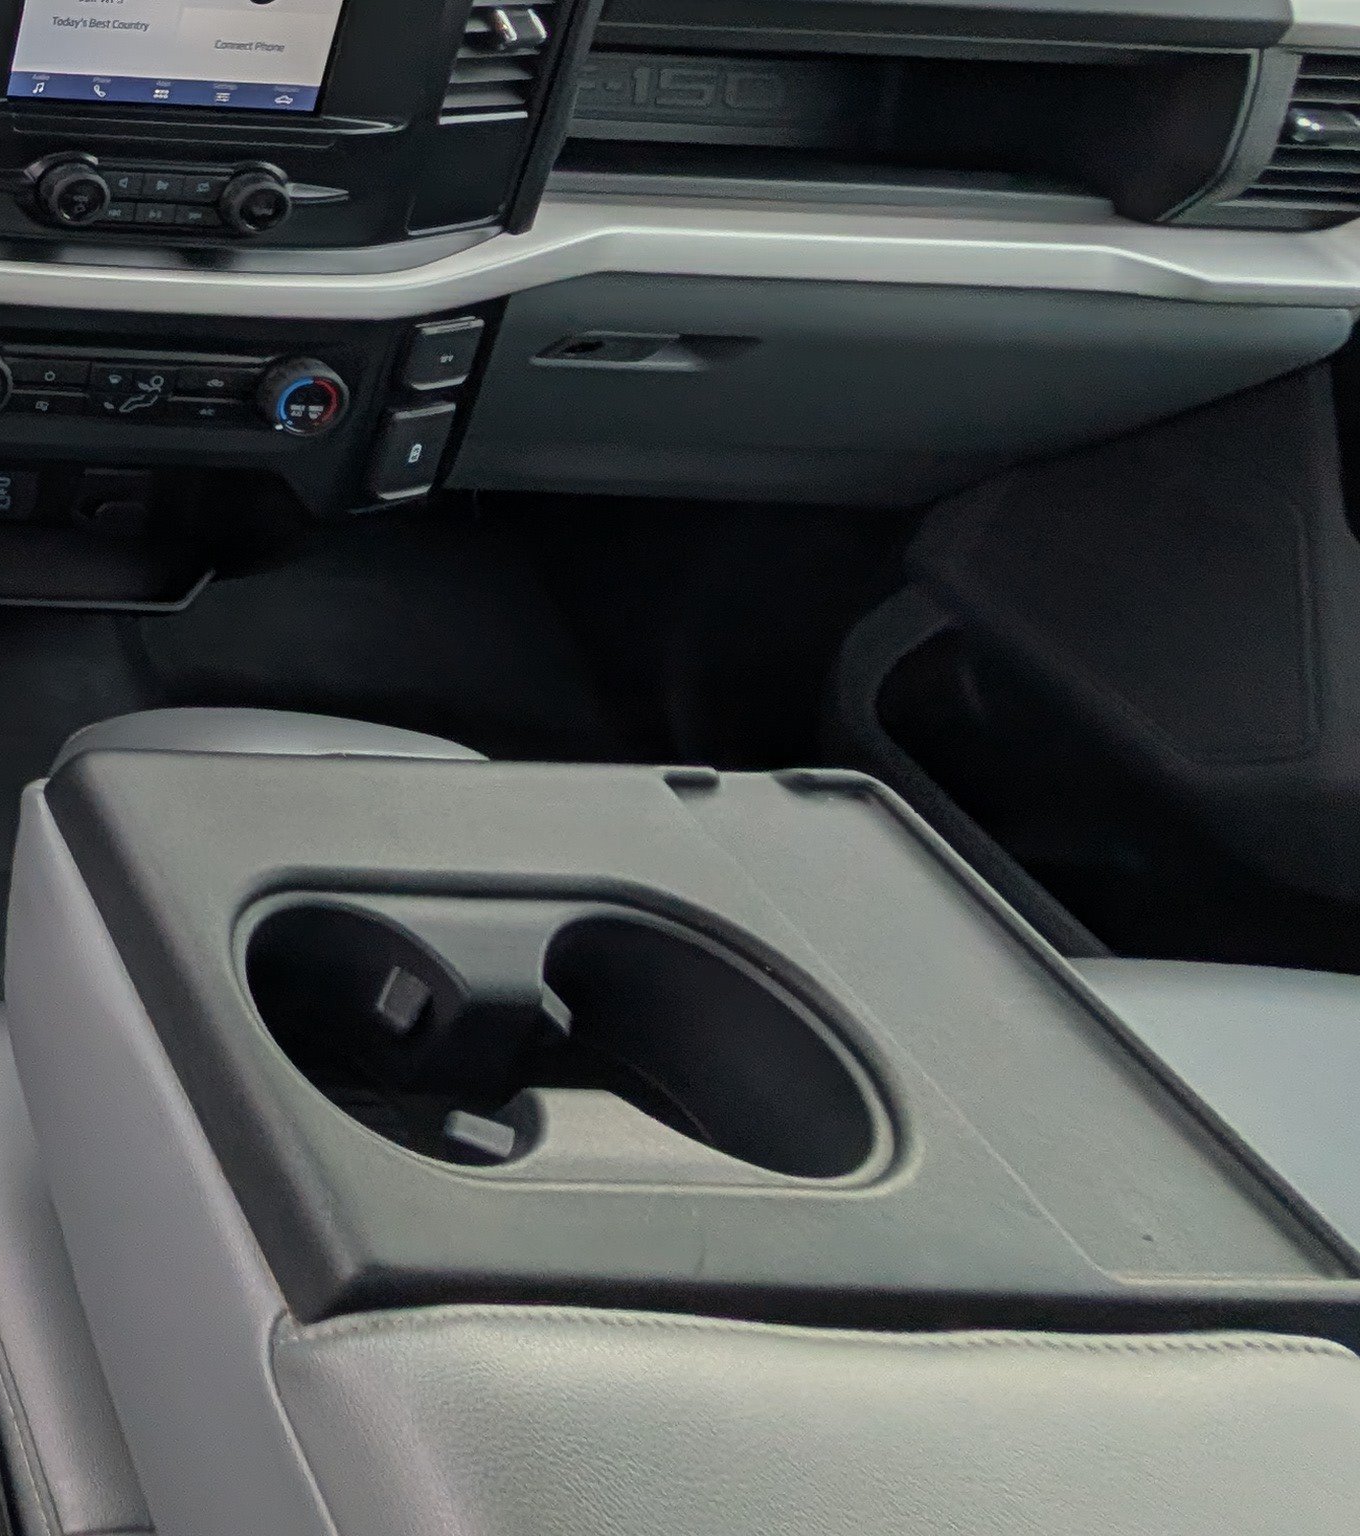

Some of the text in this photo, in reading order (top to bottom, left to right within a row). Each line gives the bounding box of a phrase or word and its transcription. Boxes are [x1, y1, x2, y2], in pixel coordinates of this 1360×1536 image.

[51, 16, 149, 31] Today's Best Country
[214, 39, 285, 53] Connect Phone
